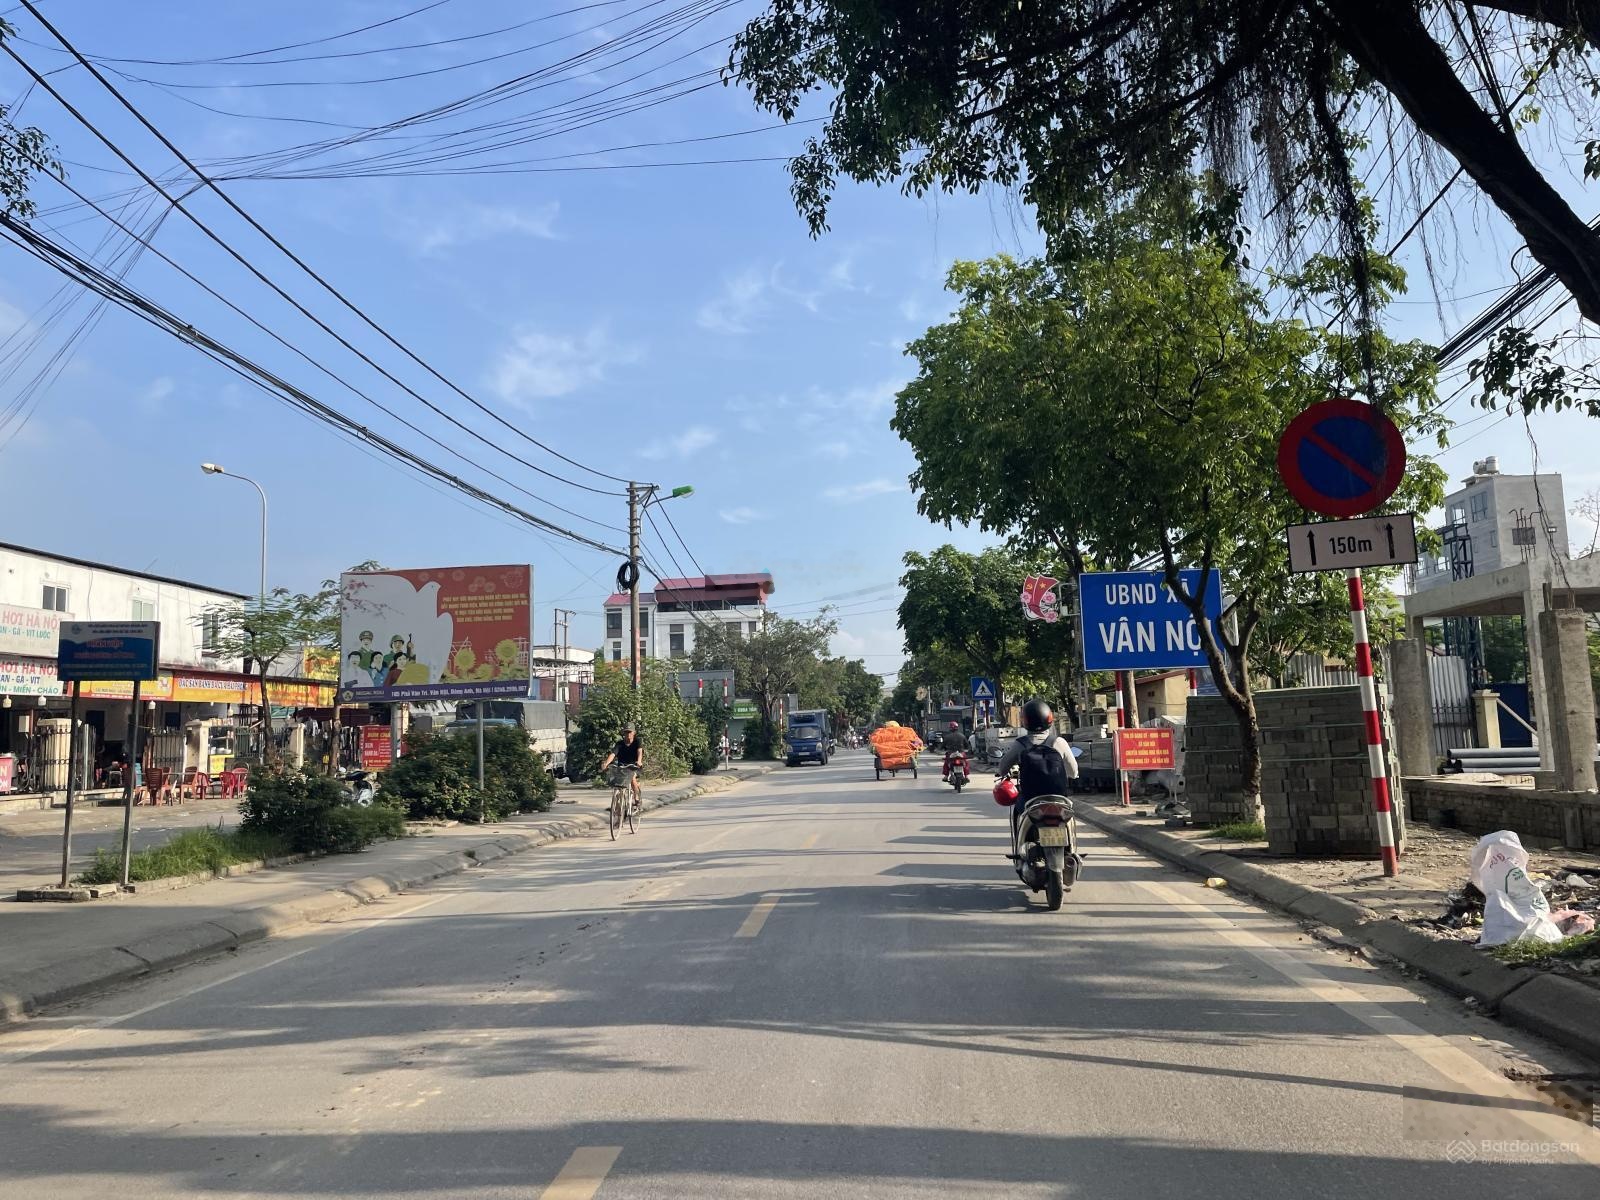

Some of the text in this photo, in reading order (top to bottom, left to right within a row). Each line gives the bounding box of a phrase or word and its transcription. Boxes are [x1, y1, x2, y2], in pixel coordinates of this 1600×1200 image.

[1329, 535, 1372, 555] 150m
[1105, 583, 1156, 605] UBND
[43, 614, 61, 633] NỘ
[1098, 616, 1156, 653] VÂN
